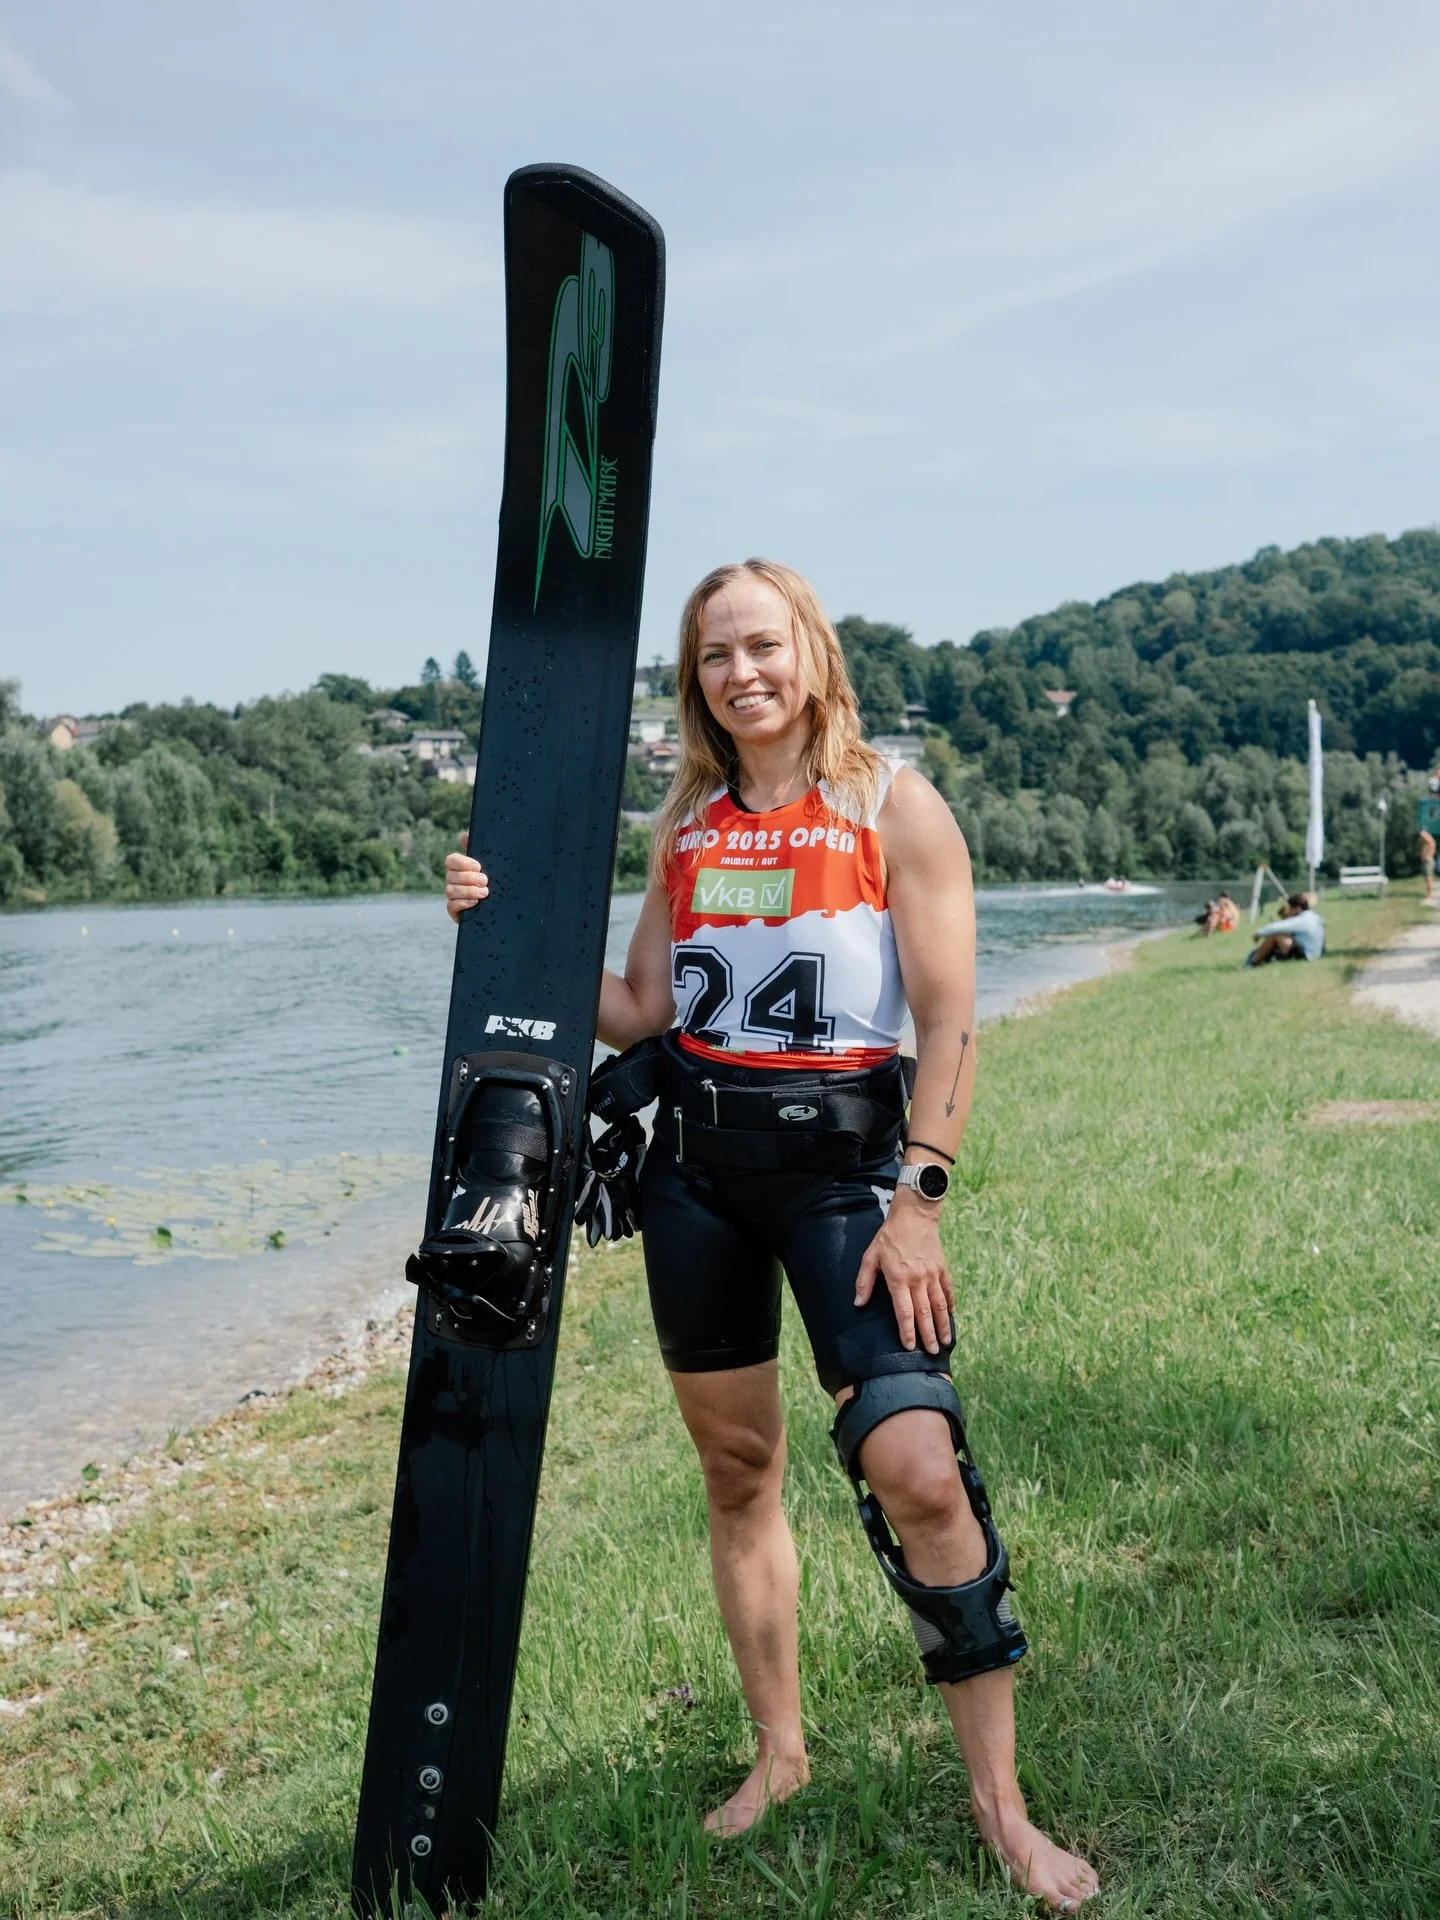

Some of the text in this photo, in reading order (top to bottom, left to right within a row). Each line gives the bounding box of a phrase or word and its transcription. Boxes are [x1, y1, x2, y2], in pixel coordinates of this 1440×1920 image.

[594, 454, 619, 560] NIGHTMARE
[725, 830, 783, 851] 2025
[789, 827, 857, 854] OPEN
[720, 856, 755, 866] SALMSEE
[761, 857, 778, 866] AUT
[700, 876, 755, 908] VKB
[673, 945, 836, 1054] 24
[484, 1014, 557, 1041] PKB
